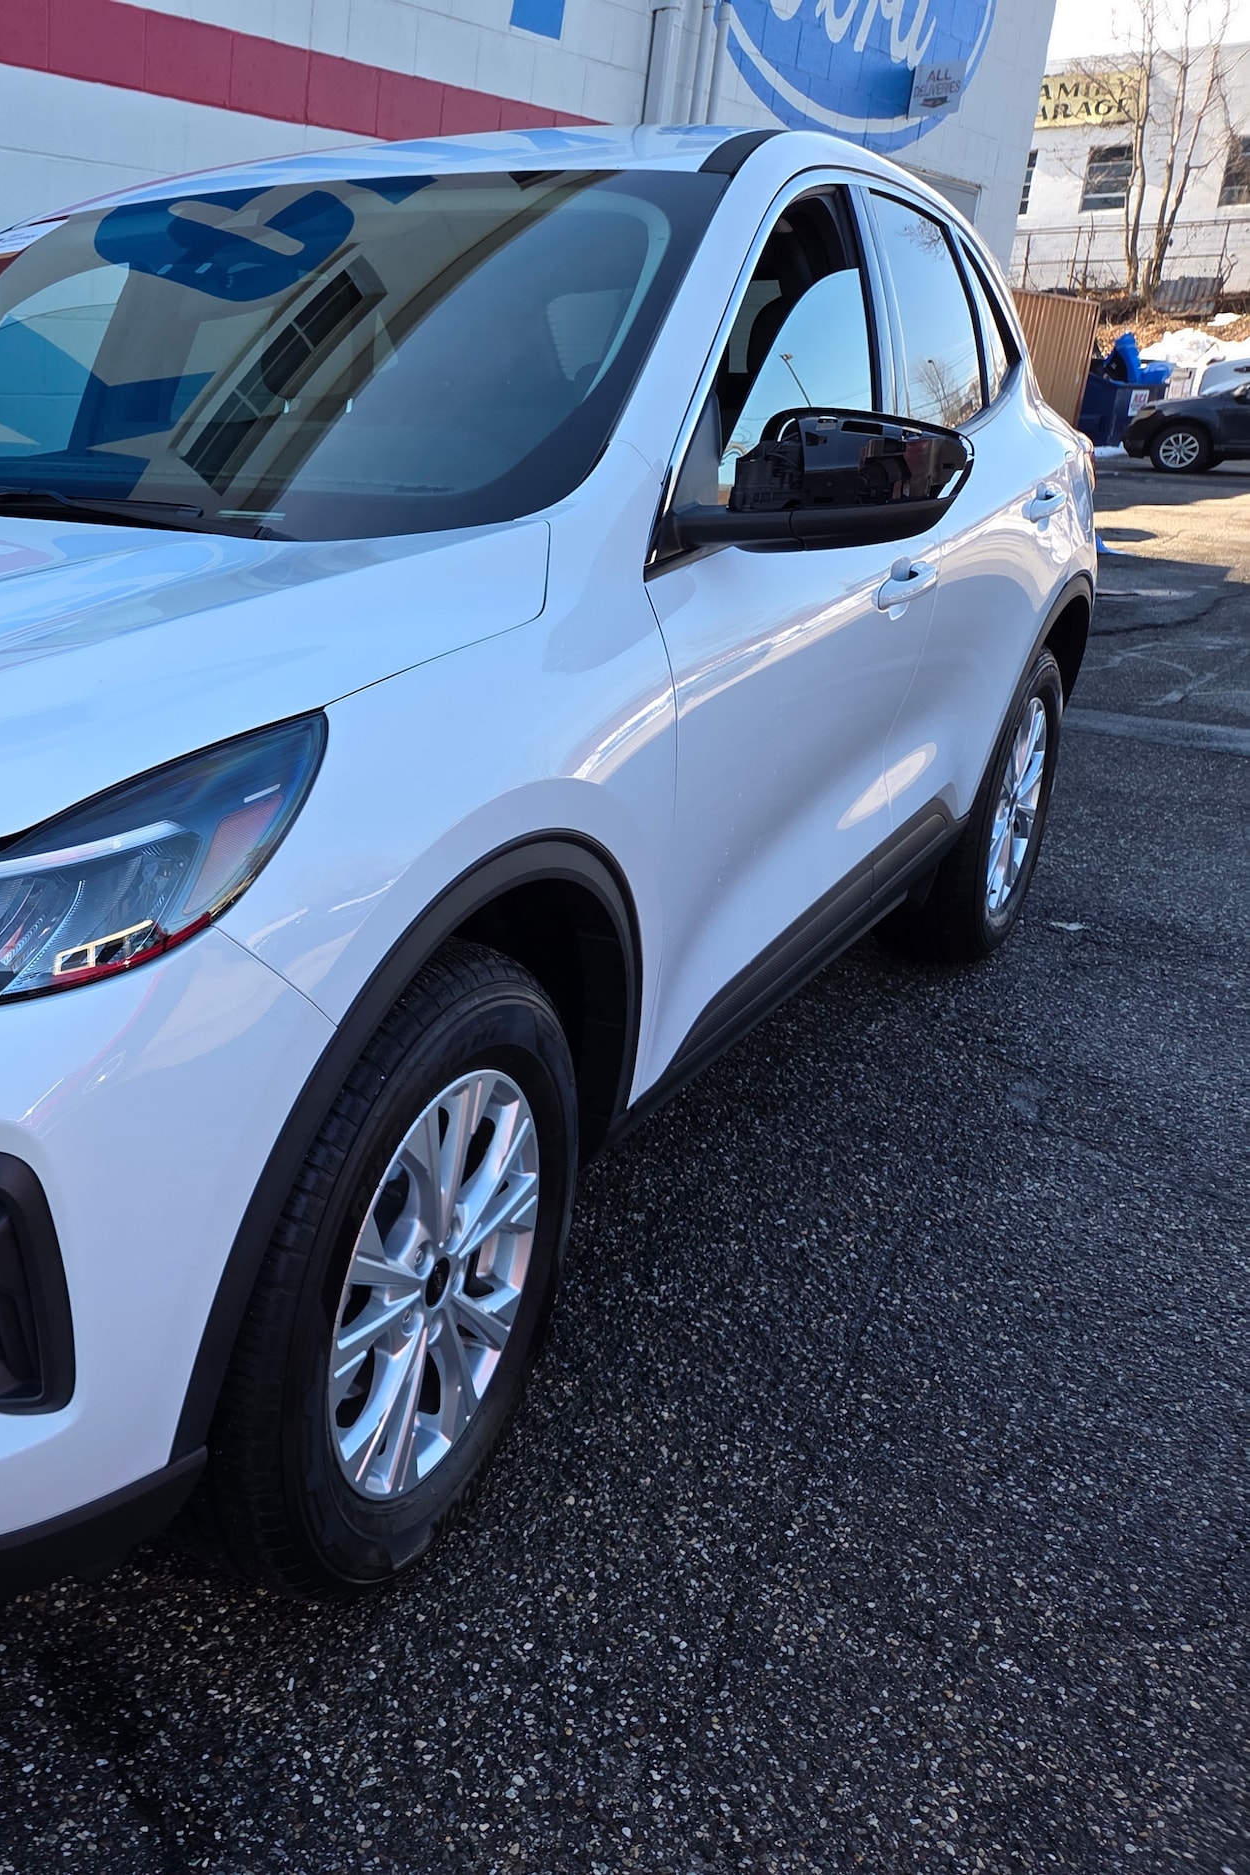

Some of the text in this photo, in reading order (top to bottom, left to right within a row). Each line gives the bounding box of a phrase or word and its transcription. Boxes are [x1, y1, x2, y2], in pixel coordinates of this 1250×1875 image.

[769, 0, 937, 71] ord
[926, 69, 952, 82] ALL
[913, 80, 961, 97] DELIVERIES
[1040, 78, 1132, 100] AMILY
[1036, 97, 1132, 120] ARAGE
